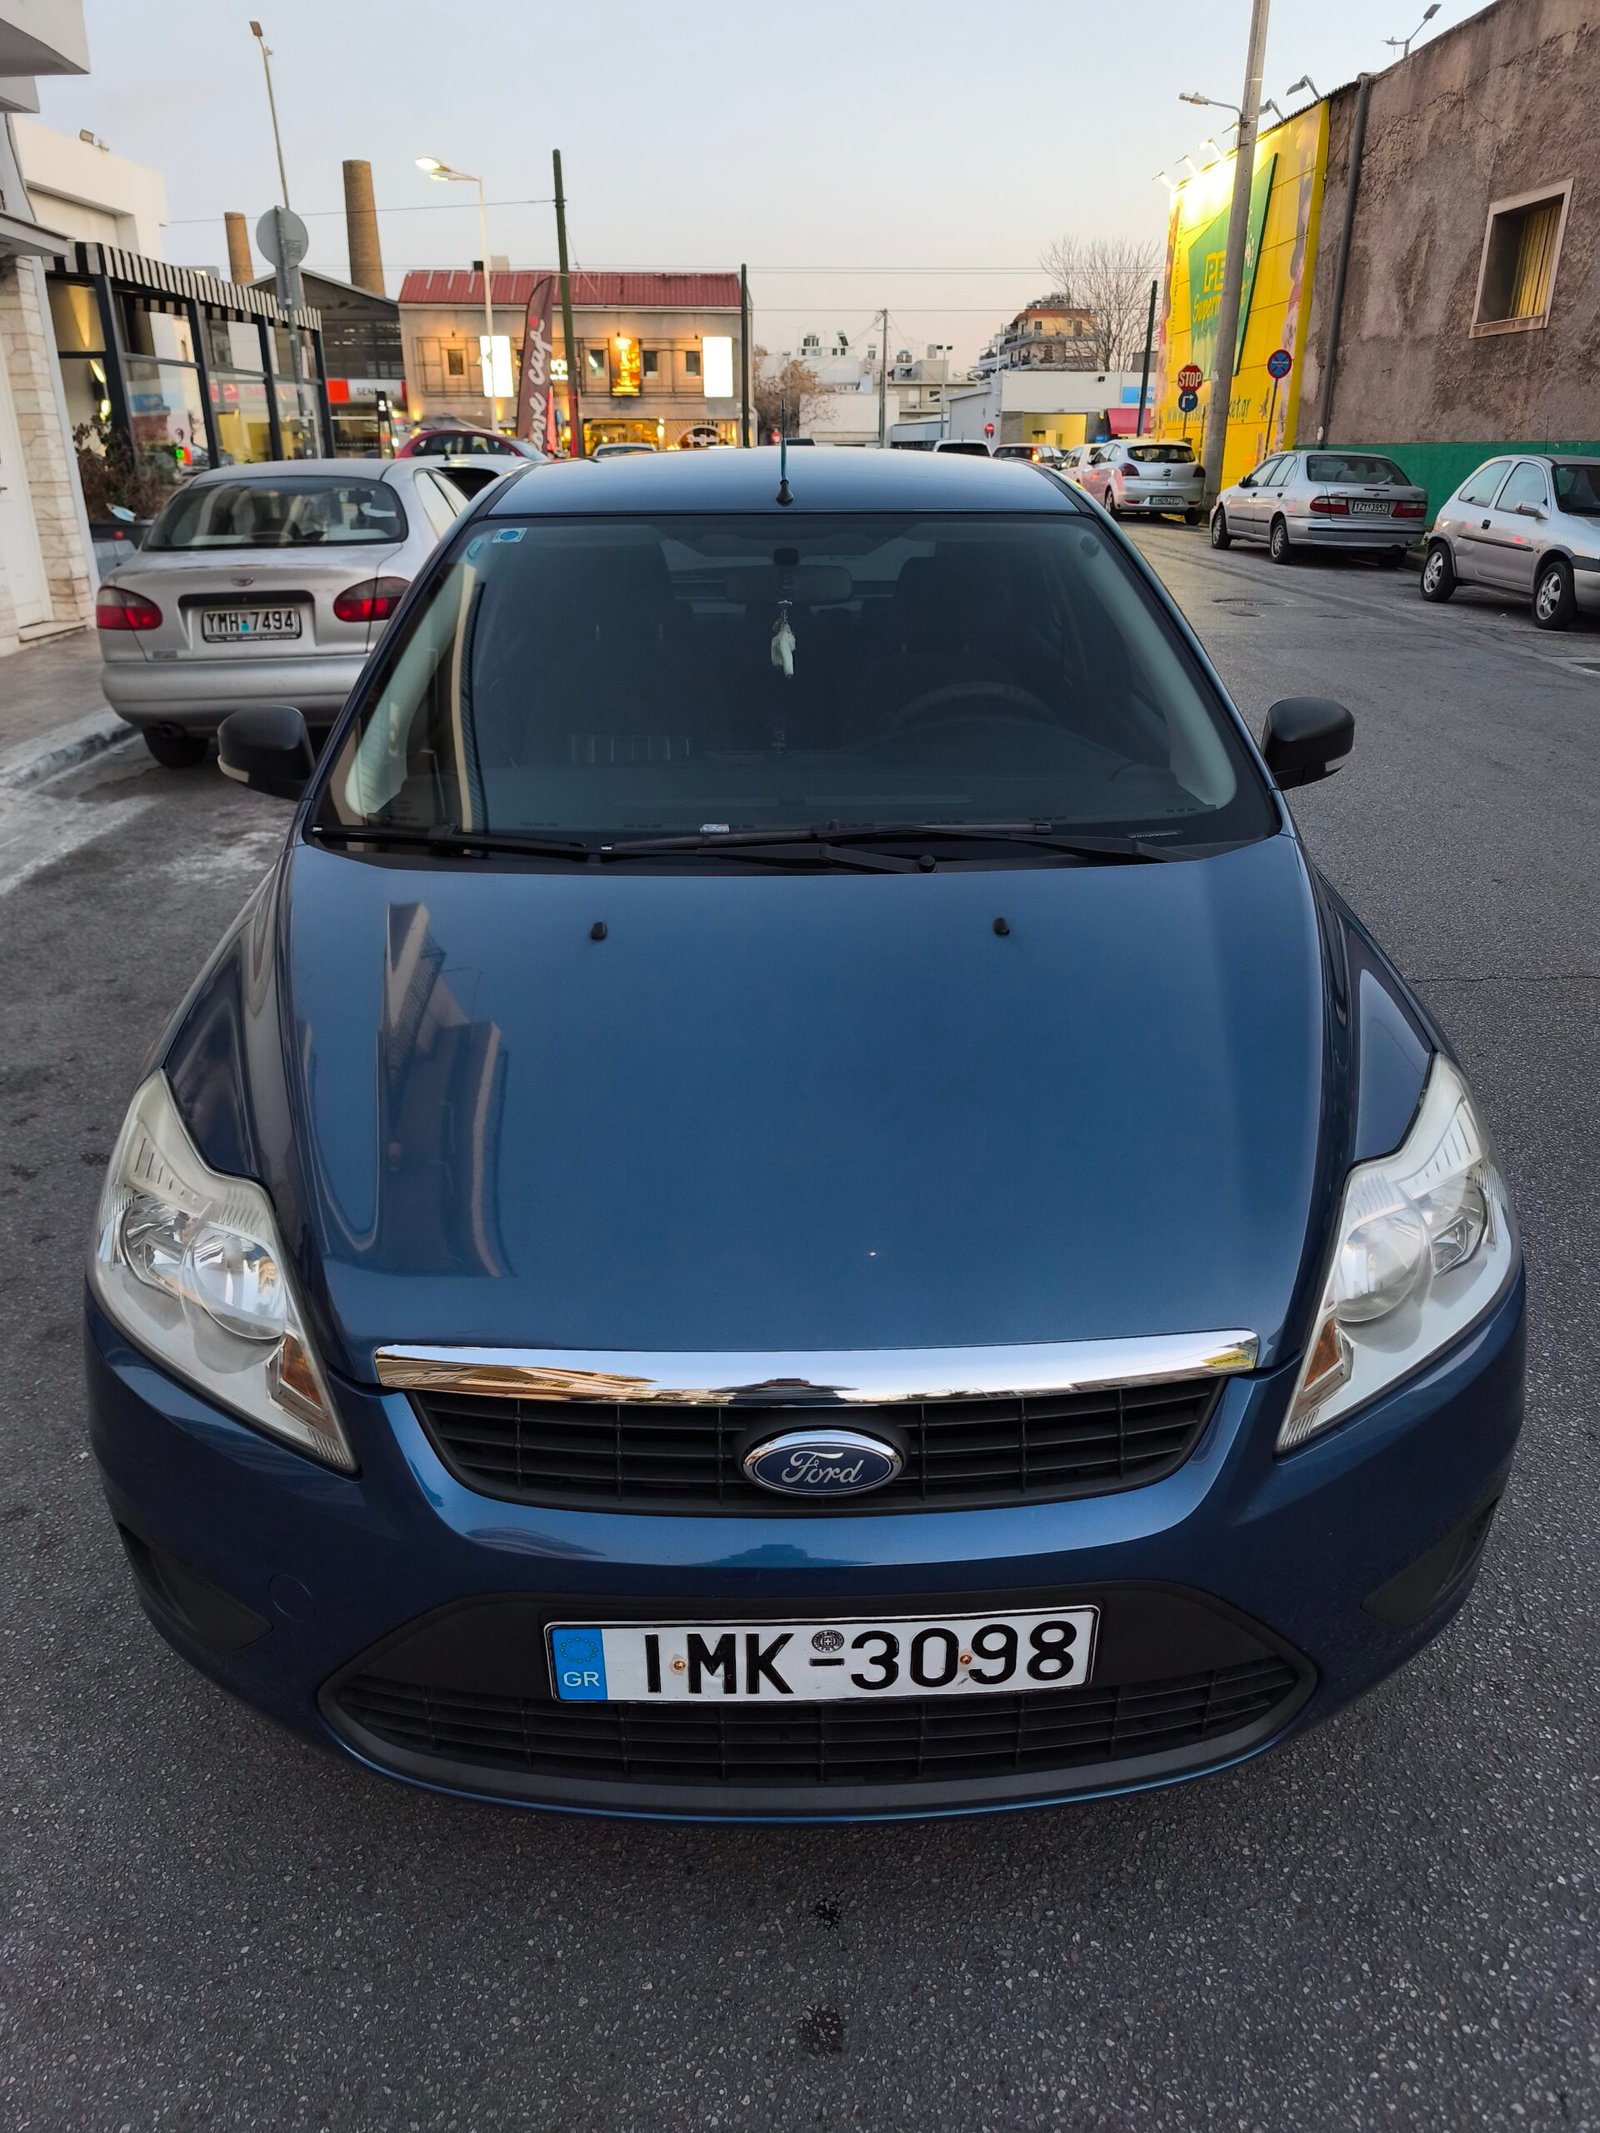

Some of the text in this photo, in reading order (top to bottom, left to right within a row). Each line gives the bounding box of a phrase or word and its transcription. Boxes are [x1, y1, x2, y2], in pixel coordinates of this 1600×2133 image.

[1203, 252, 1227, 293] PE
[1179, 371, 1202, 387] STOP
[781, 1450, 865, 1484] Ford
[562, 1671, 601, 1688] GR
